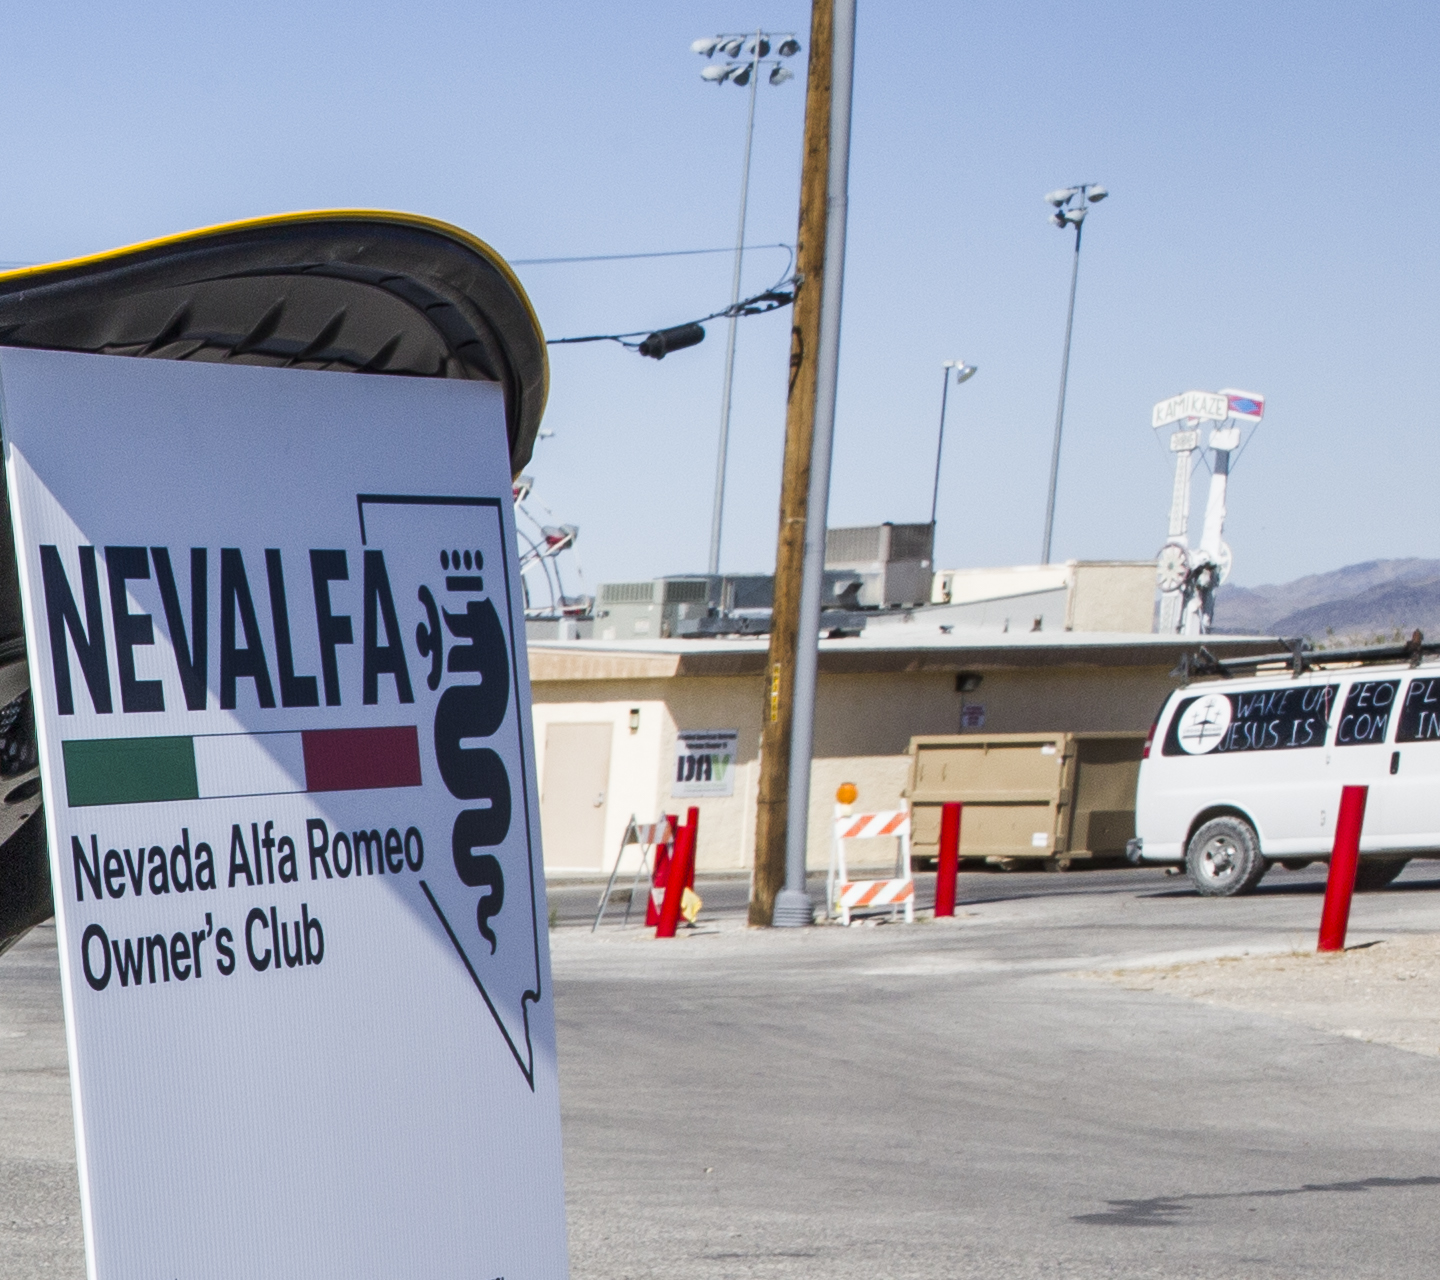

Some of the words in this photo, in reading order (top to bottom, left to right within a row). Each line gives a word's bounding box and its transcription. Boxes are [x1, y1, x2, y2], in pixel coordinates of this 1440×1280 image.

[1156, 393, 1225, 421] KAMIKAZE
[39, 543, 415, 716] NEVALFA
[1237, 688, 1294, 718] WAKE
[1301, 684, 1333, 712] UP
[1217, 719, 1280, 751] JESUS
[1286, 718, 1315, 747] IS
[676, 753, 731, 783] DAV
[71, 827, 217, 902] Nevada
[227, 819, 298, 888] Alfa
[306, 817, 424, 880] Romeo
[81, 911, 236, 991] Owner's
[245, 902, 325, 972] Club
